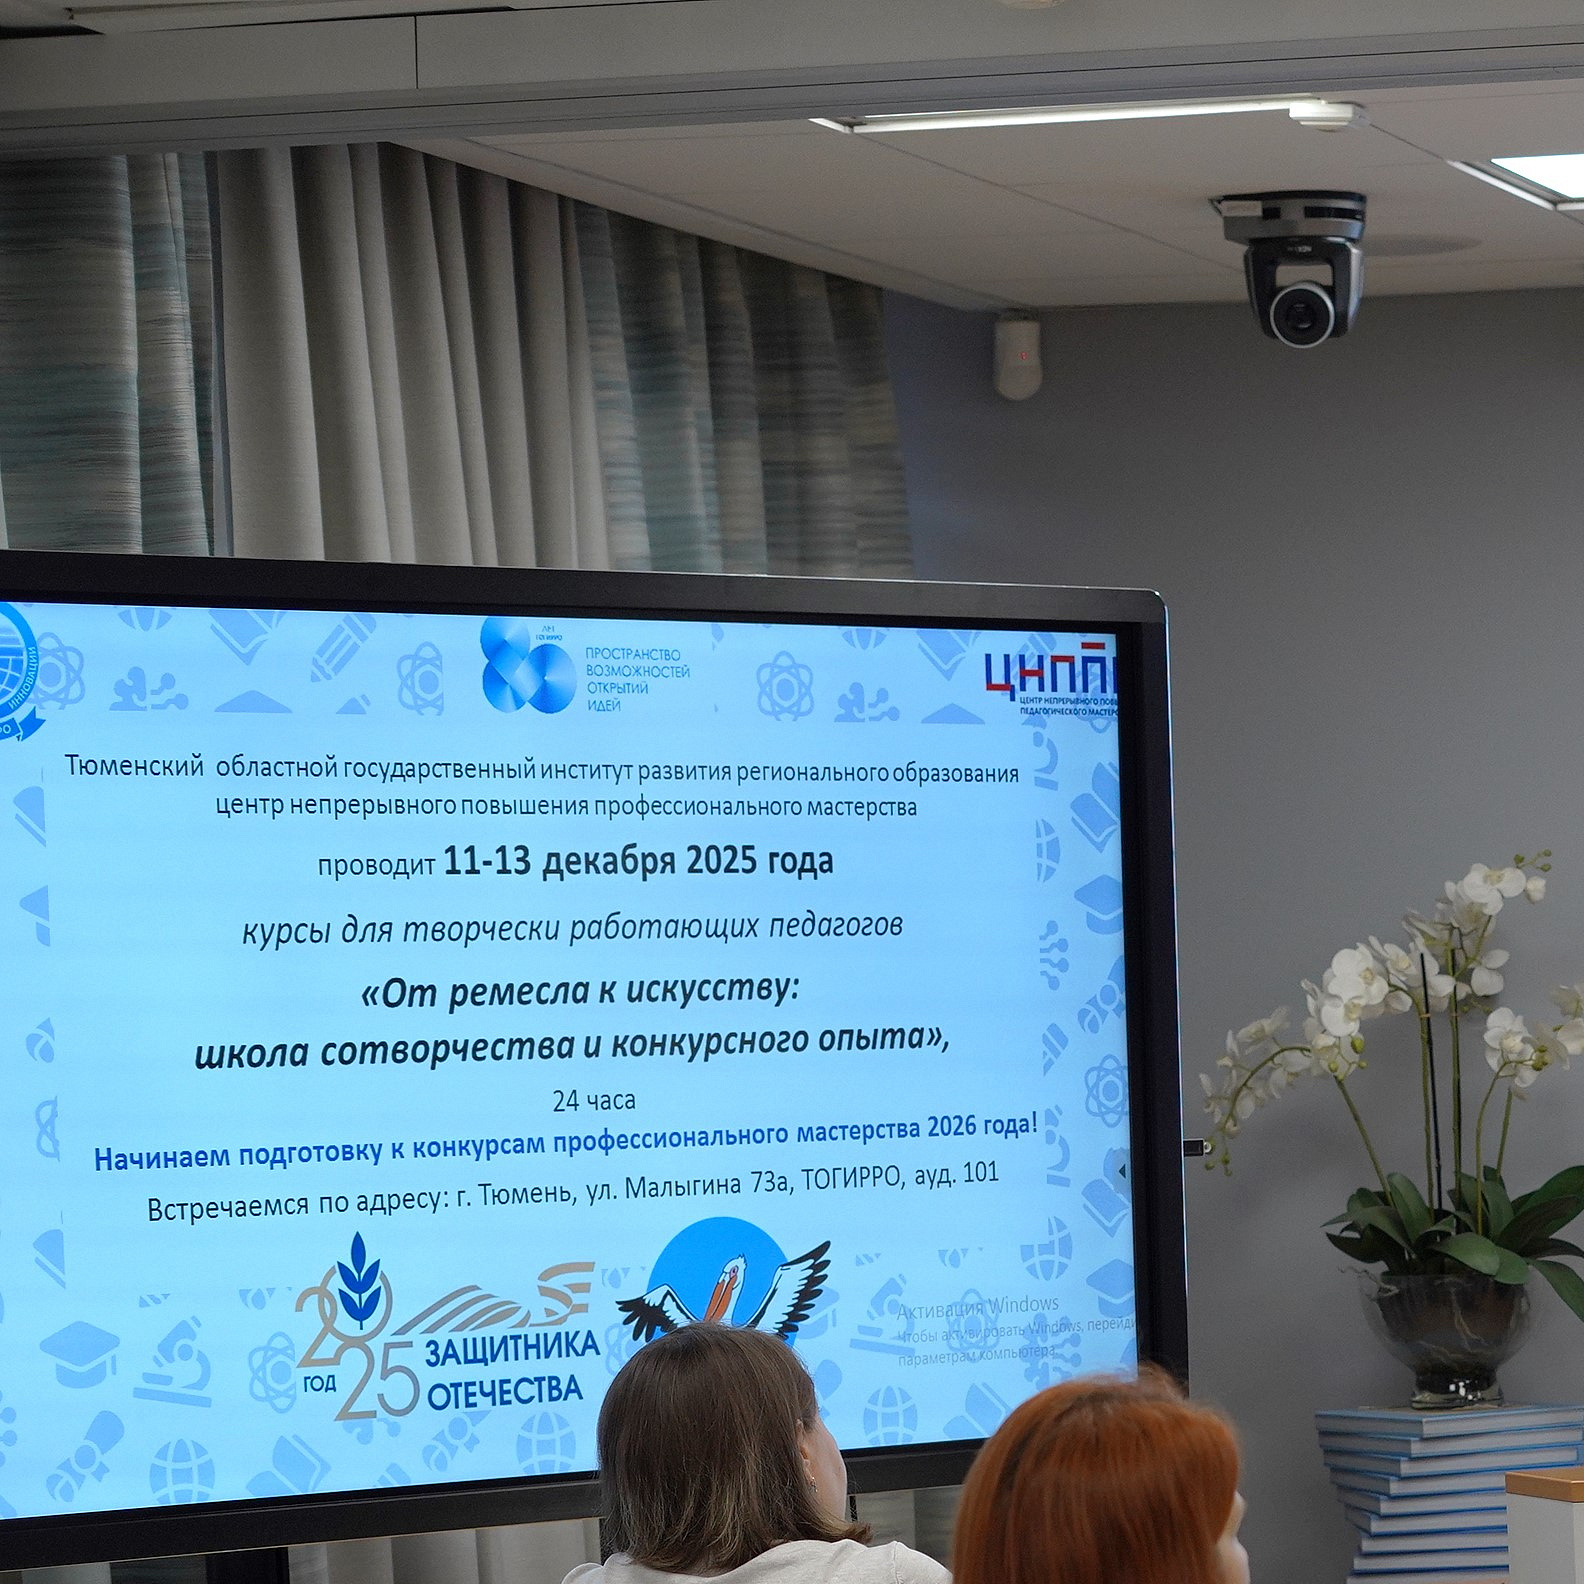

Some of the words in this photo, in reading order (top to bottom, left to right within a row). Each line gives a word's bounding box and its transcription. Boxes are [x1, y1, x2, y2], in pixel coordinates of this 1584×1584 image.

[586, 647, 681, 661] ПРОСТРАНСТВО
[8, 646, 38, 710] ИННОВАЦИИ
[587, 664, 690, 678] ВОЗМОЖНОСТЕЙ
[587, 681, 648, 694] ОТКРЫТИЙ
[1020, 697, 1043, 705] ЦЕНТР
[588, 698, 621, 712] ИДЕЙ
[65, 753, 203, 776] Тюменский
[216, 754, 337, 777] областной
[345, 757, 535, 784] государственный
[541, 764, 633, 785] институт
[639, 765, 731, 785] развития
[738, 766, 889, 786] регионального
[893, 761, 1018, 787] образования
[217, 798, 284, 820] центр
[291, 798, 456, 820] непрерывного
[462, 799, 588, 815] повышения
[595, 793, 802, 821] профессионального
[808, 801, 916, 821] мастерства
[319, 858, 436, 881] проводит
[445, 845, 531, 875] 11-13
[543, 843, 675, 881] декабря
[687, 845, 756, 874] 2025
[769, 852, 833, 880] года
[243, 923, 330, 951] курсы
[342, 914, 393, 943] для
[404, 920, 559, 948] творчески
[570, 911, 759, 947] работающих
[770, 909, 903, 937] педагогов
[362, 978, 437, 1008] «От
[449, 982, 589, 1014] ремесла
[599, 981, 617, 1003] к
[627, 978, 799, 1009] искусству:
[195, 1043, 309, 1069] школа
[321, 1036, 575, 1070] сотворчества
[584, 1036, 601, 1058] и
[612, 1031, 809, 1063] конкурсного
[819, 1024, 951, 1054] опыта»,
[553, 1090, 580, 1112] 24
[587, 1094, 635, 1110] часа
[95, 1148, 230, 1171] Начинаем
[240, 1143, 382, 1170] подготовку
[392, 1142, 404, 1159] к
[414, 1137, 545, 1161] конкурсам
[554, 1127, 788, 1157] профессионального
[797, 1122, 920, 1145] мастерства
[928, 1115, 976, 1137] 2026
[984, 1111, 1037, 1139] года!
[149, 1198, 308, 1225] Встречаемся
[320, 1196, 349, 1213] по
[357, 1191, 448, 1216] адресу:
[458, 1190, 470, 1207] г.
[478, 1183, 576, 1206] Тюмень,
[586, 1184, 617, 1206] ул.
[626, 1176, 740, 1198] Малыгина
[751, 1171, 794, 1195] 73а,
[801, 1165, 905, 1190] ТОГИРРО,
[915, 1168, 956, 1190] ауд.
[964, 1161, 999, 1182] 101
[897, 1302, 984, 1321] Активация
[988, 1296, 1059, 1314] Windows
[942, 1324, 1025, 1343] активировать
[1028, 1320, 1084, 1336] Windows,
[424, 1331, 601, 1367] ЗАЩИТНИКА
[899, 1351, 975, 1368] параметрам
[304, 1374, 336, 1392] год
[428, 1374, 583, 1411] ОТЕЧЕСТВА
